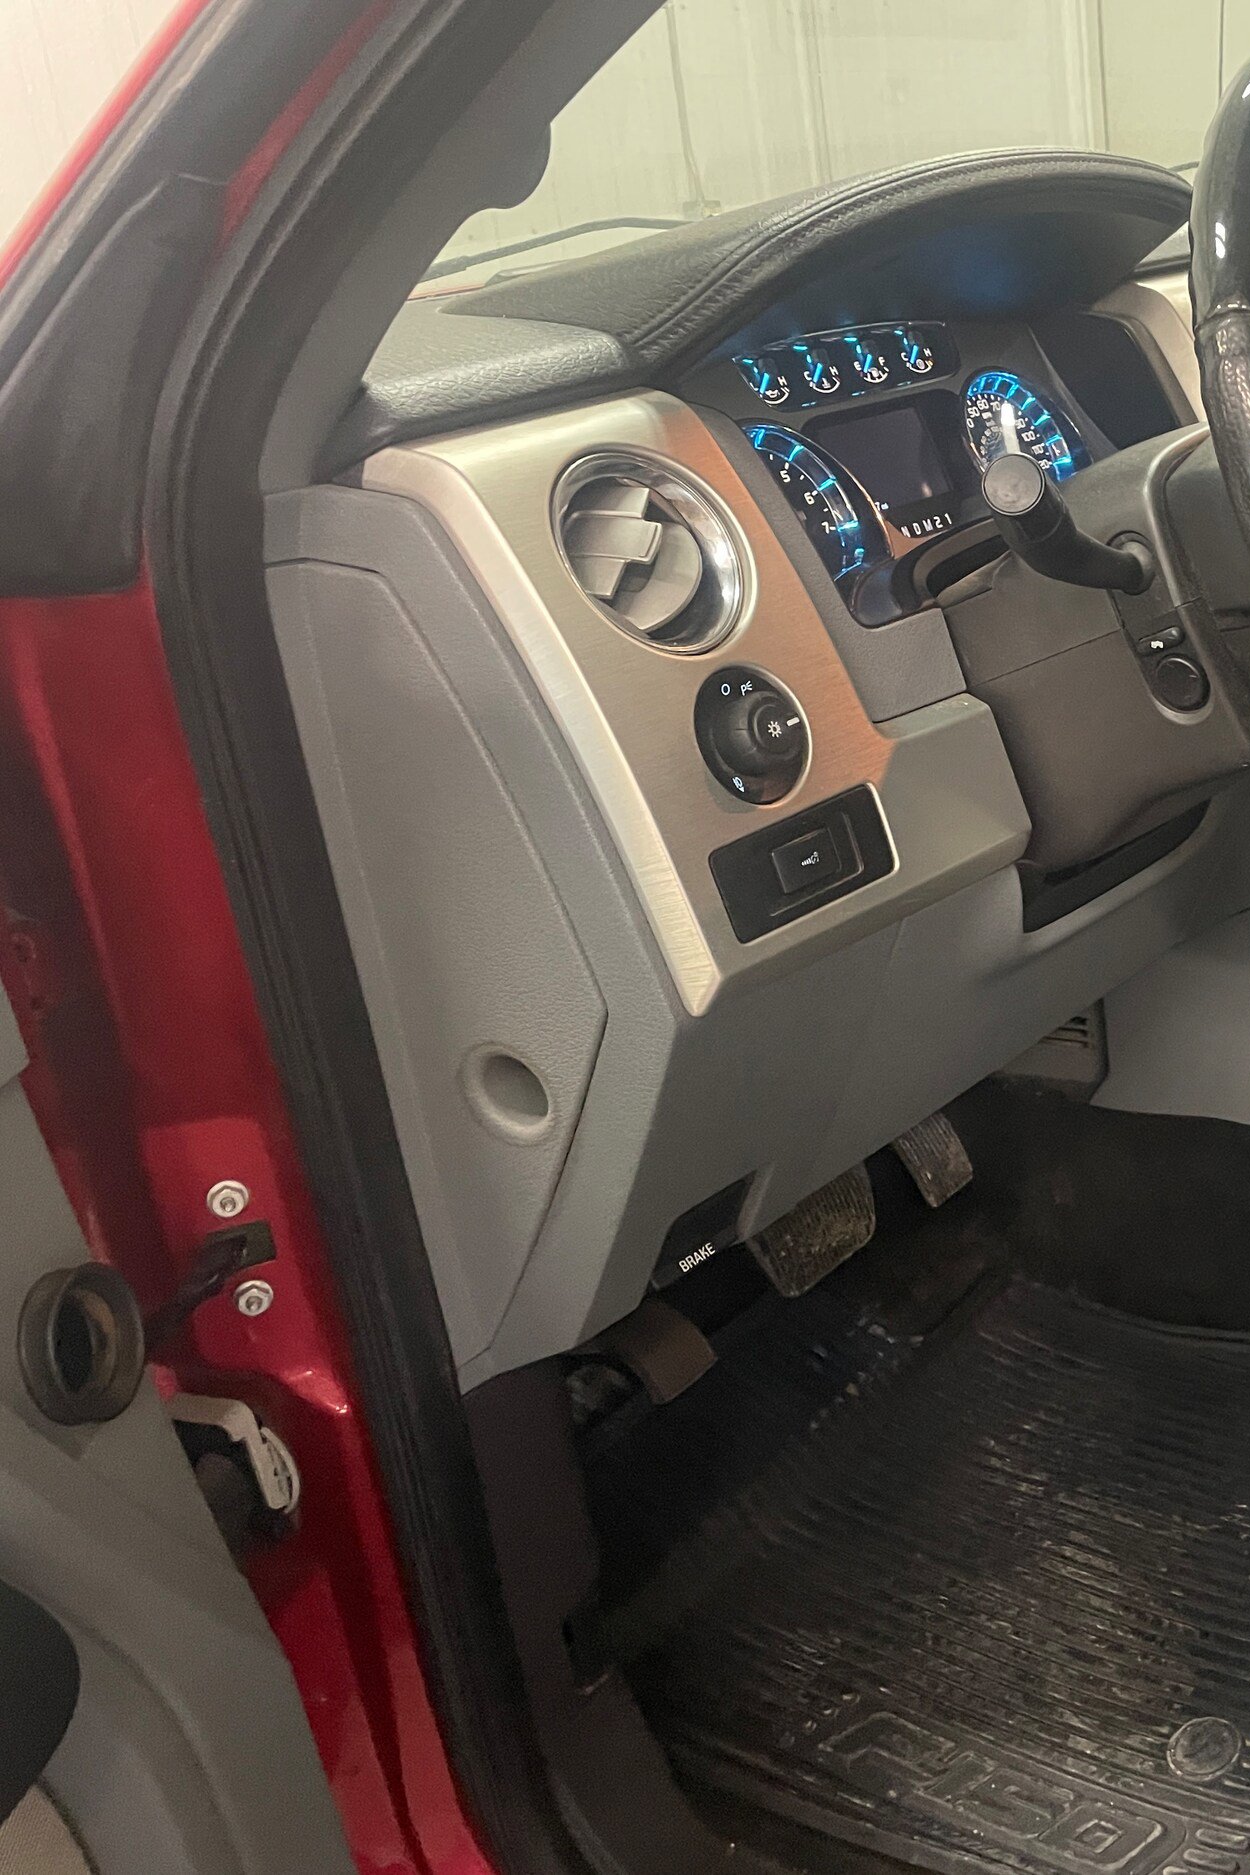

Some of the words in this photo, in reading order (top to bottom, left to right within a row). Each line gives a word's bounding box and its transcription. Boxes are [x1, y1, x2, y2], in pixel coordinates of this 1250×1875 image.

[923, 348, 932, 358] H
[853, 361, 862, 371] E
[878, 356, 886, 366] F
[829, 366, 839, 376] H
[777, 375, 787, 386] H
[977, 399, 990, 411] 60
[990, 401, 1001, 412] 70
[967, 406, 980, 418] 50
[780, 470, 791, 483] 5
[804, 492, 815, 505] 6
[821, 521, 831, 534] 7
[679, 1242, 716, 1273] BRAKE
